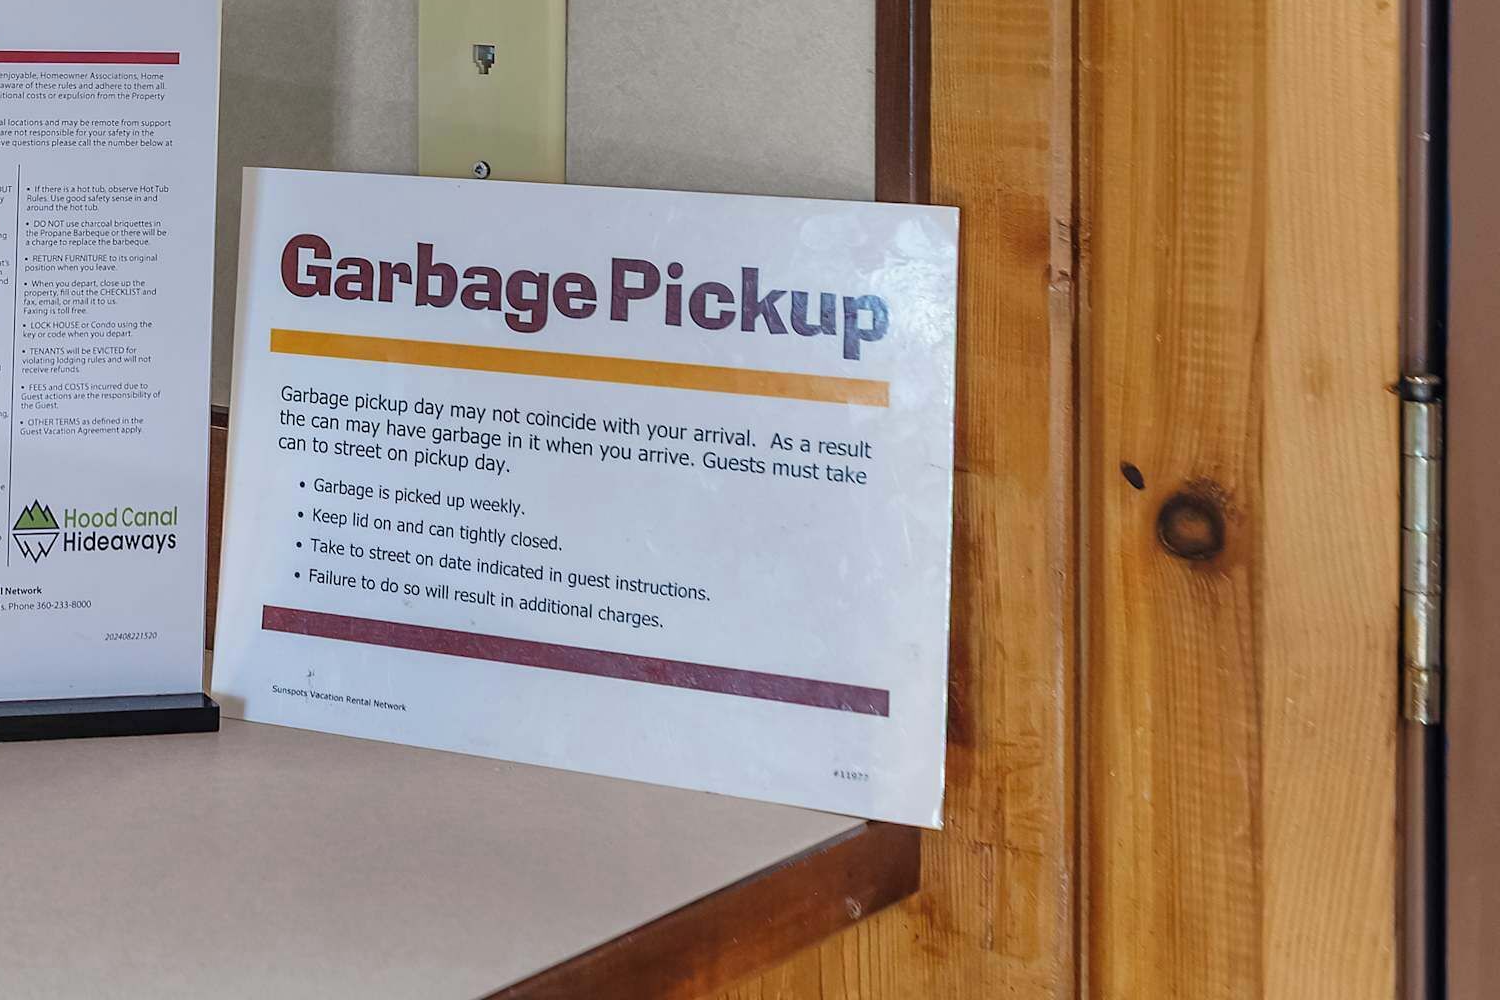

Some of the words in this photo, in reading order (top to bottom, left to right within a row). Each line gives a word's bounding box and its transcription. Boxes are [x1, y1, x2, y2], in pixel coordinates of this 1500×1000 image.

[280, 233, 597, 334] Garbage
[609, 257, 890, 360] Pickup
[280, 386, 350, 412] Garbage
[354, 393, 409, 421] pickup
[413, 398, 445, 420] day
[449, 405, 487, 428] may
[491, 408, 522, 424] not
[525, 410, 597, 431] coincide
[602, 417, 641, 435] with
[645, 424, 689, 441] your
[693, 427, 757, 447] arrival.
[769, 433, 794, 451] As
[799, 439, 811, 453] a
[817, 440, 873, 459] result
[277, 437, 307, 451] can
[311, 437, 329, 454] to
[333, 440, 383, 460] street
[386, 448, 409, 462] on
[413, 448, 469, 472] pickup
[474, 453, 511, 476] day.
[279, 410, 307, 427] the
[310, 416, 340, 430] can
[345, 419, 381, 438] may
[385, 420, 427, 439] have
[431, 426, 502, 449] garbage
[507, 432, 523, 449] in
[528, 434, 541, 451] it
[545, 436, 594, 456] when
[598, 444, 632, 462] you
[637, 447, 695, 467] arrive.
[702, 451, 767, 474] Guests
[772, 462, 821, 480] must
[825, 464, 868, 485] take
[64, 509, 118, 529] Hood
[121, 507, 178, 527] Canal
[313, 478, 375, 500] Garbage
[378, 485, 391, 500] is
[394, 487, 442, 506] picked
[446, 495, 466, 511] up
[469, 498, 526, 518] weekly.
[63, 530, 177, 554] Hideaways
[311, 507, 348, 528] Keep
[351, 512, 370, 528] lid
[372, 518, 392, 531] on
[395, 520, 425, 534] and
[427, 524, 455, 538] can
[459, 525, 507, 547] tightly
[509, 531, 563, 551] closed.
[309, 538, 346, 556] Take
[349, 543, 365, 558] to
[368, 546, 412, 564] street
[414, 554, 435, 567] on
[438, 553, 473, 571] date
[476, 558, 545, 580] indicated
[548, 567, 563, 583] in
[567, 572, 611, 589] guest
[615, 575, 711, 601] instructions.
[4, 586, 43, 595] Network
[7, 602, 36, 611] Phone
[35, 600, 93, 610] 360-233-8000
[308, 568, 357, 588] Failure
[360, 575, 377, 590] to
[379, 577, 400, 593] do
[403, 583, 421, 596] so
[424, 584, 450, 600] will
[453, 590, 497, 606] result
[500, 592, 515, 608] in
[518, 596, 593, 619] additional
[597, 606, 664, 628] charges.
[272, 685, 308, 697] Sunspots
[310, 690, 344, 703] Vacation
[345, 695, 372, 706] Rental
[373, 699, 407, 711] Network
